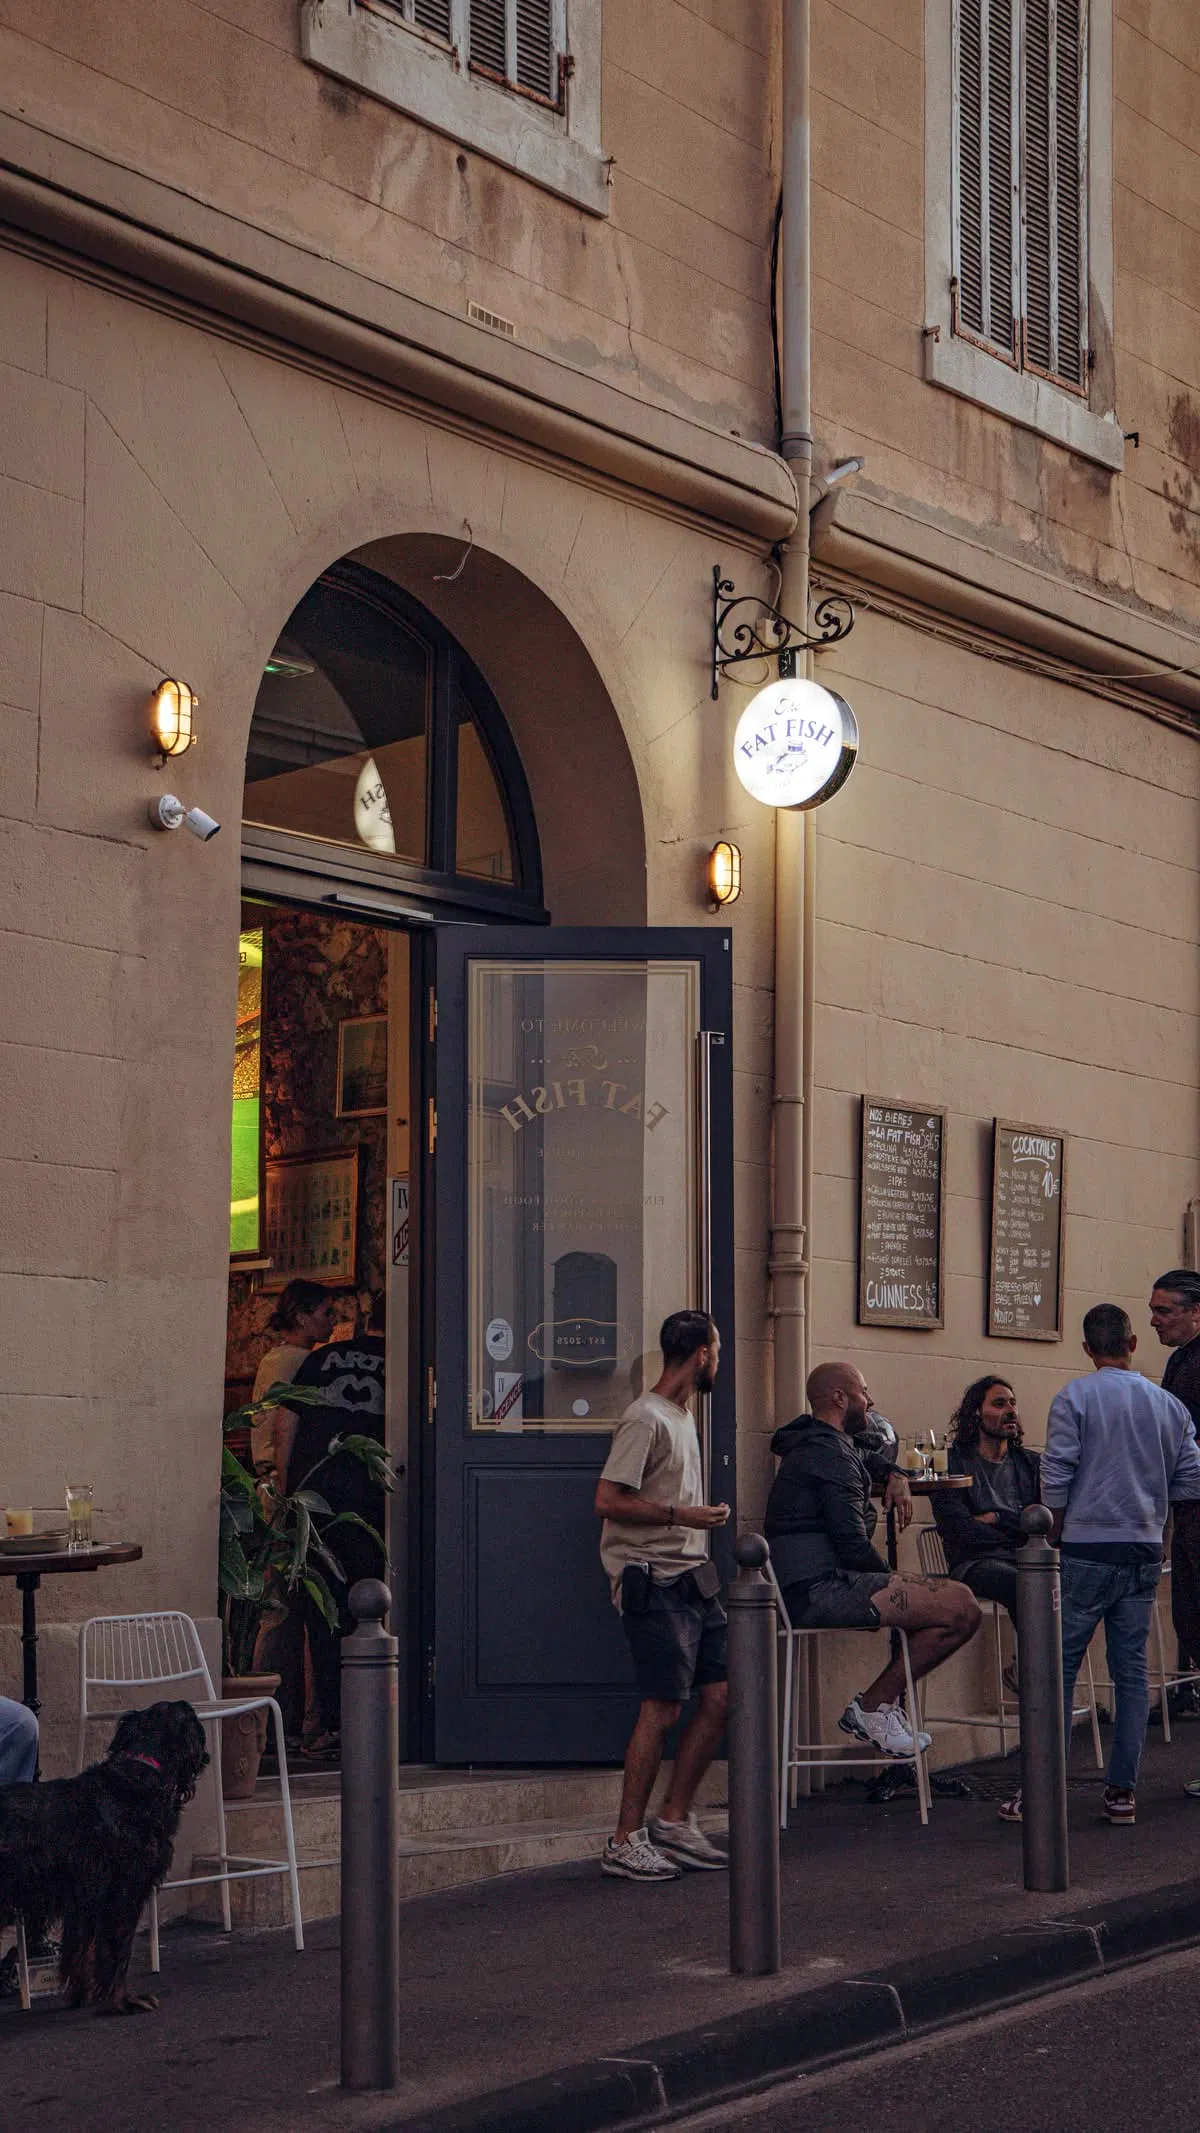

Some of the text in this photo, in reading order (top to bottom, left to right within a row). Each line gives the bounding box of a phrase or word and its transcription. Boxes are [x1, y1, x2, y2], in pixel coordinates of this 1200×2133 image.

[740, 719, 835, 759] FAT FISH
[869, 1108, 883, 1121] NOS
[875, 1126, 885, 1140] LA
[887, 1128, 904, 1143] FAT
[1011, 1136, 1057, 1161] COCKTAILS
